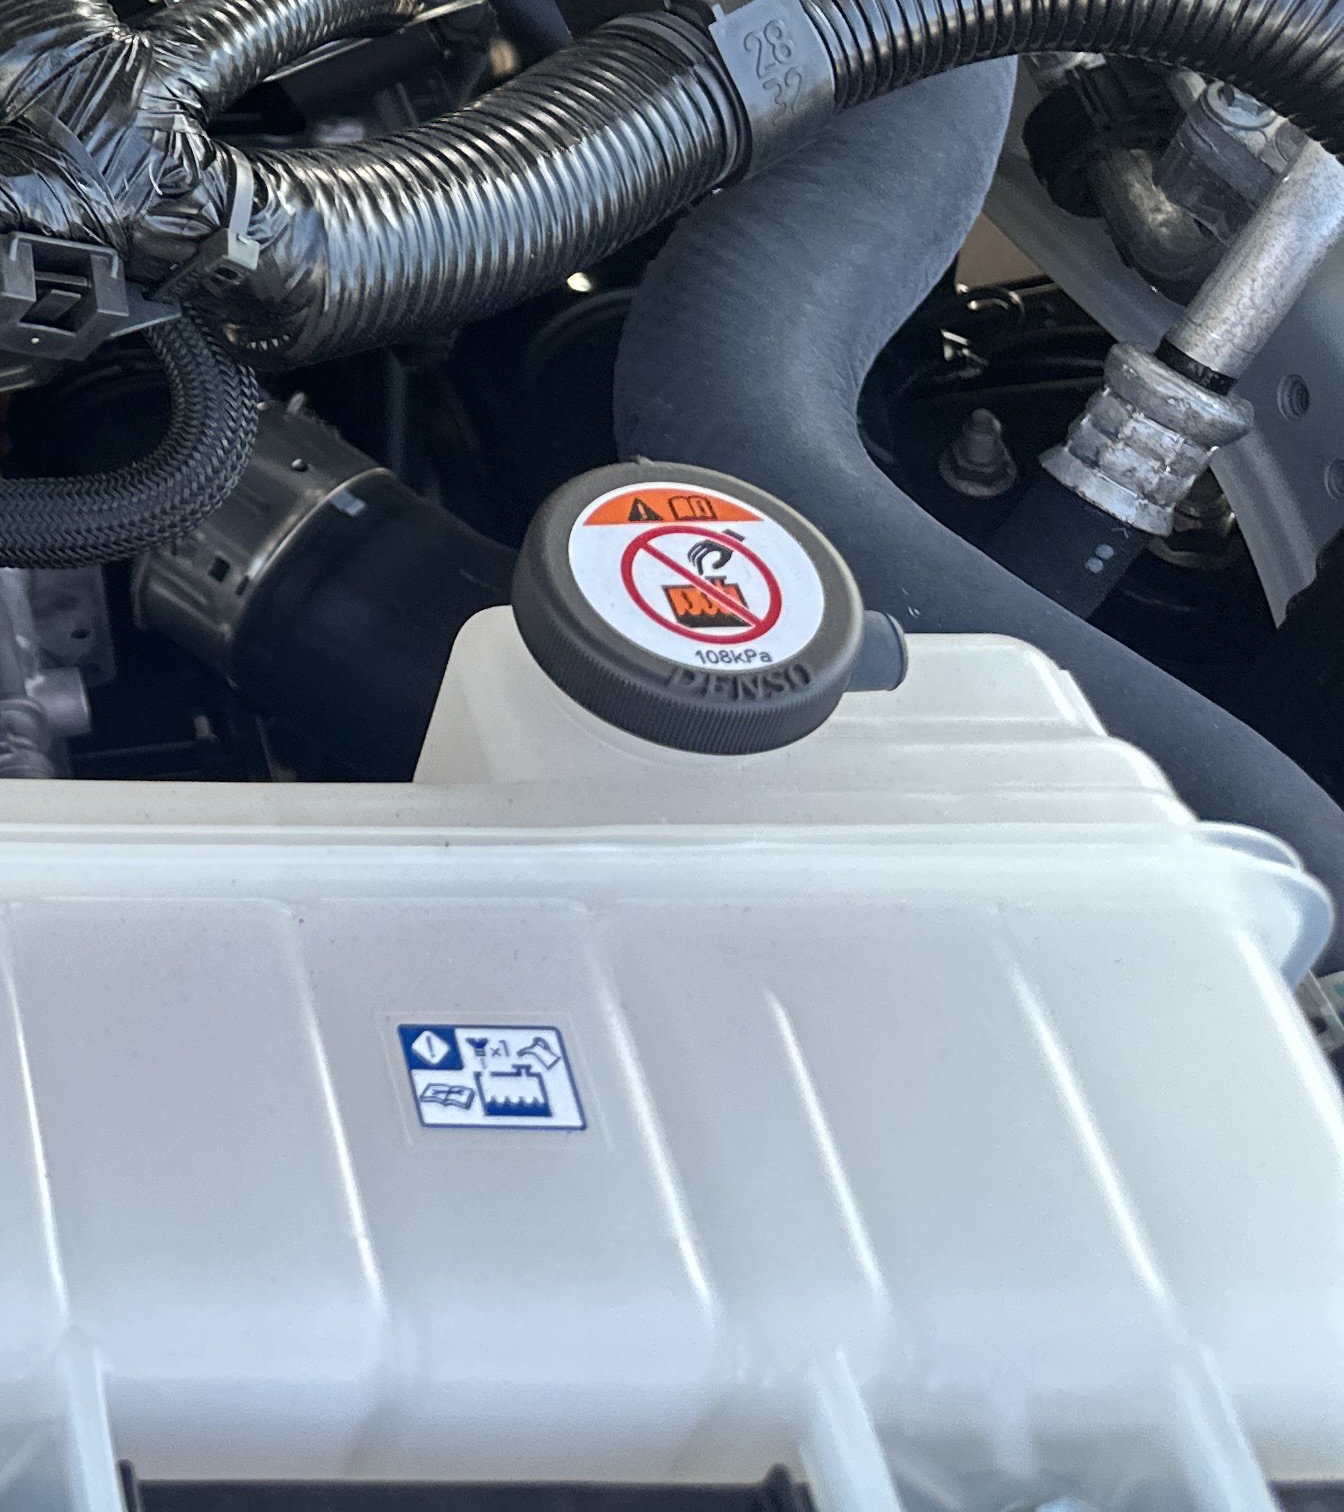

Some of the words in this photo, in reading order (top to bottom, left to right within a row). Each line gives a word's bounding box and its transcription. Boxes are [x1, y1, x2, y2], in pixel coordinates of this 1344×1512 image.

[743, 19, 796, 79] 28
[694, 648, 774, 665] 108kPa
[666, 662, 812, 702] DENSO
